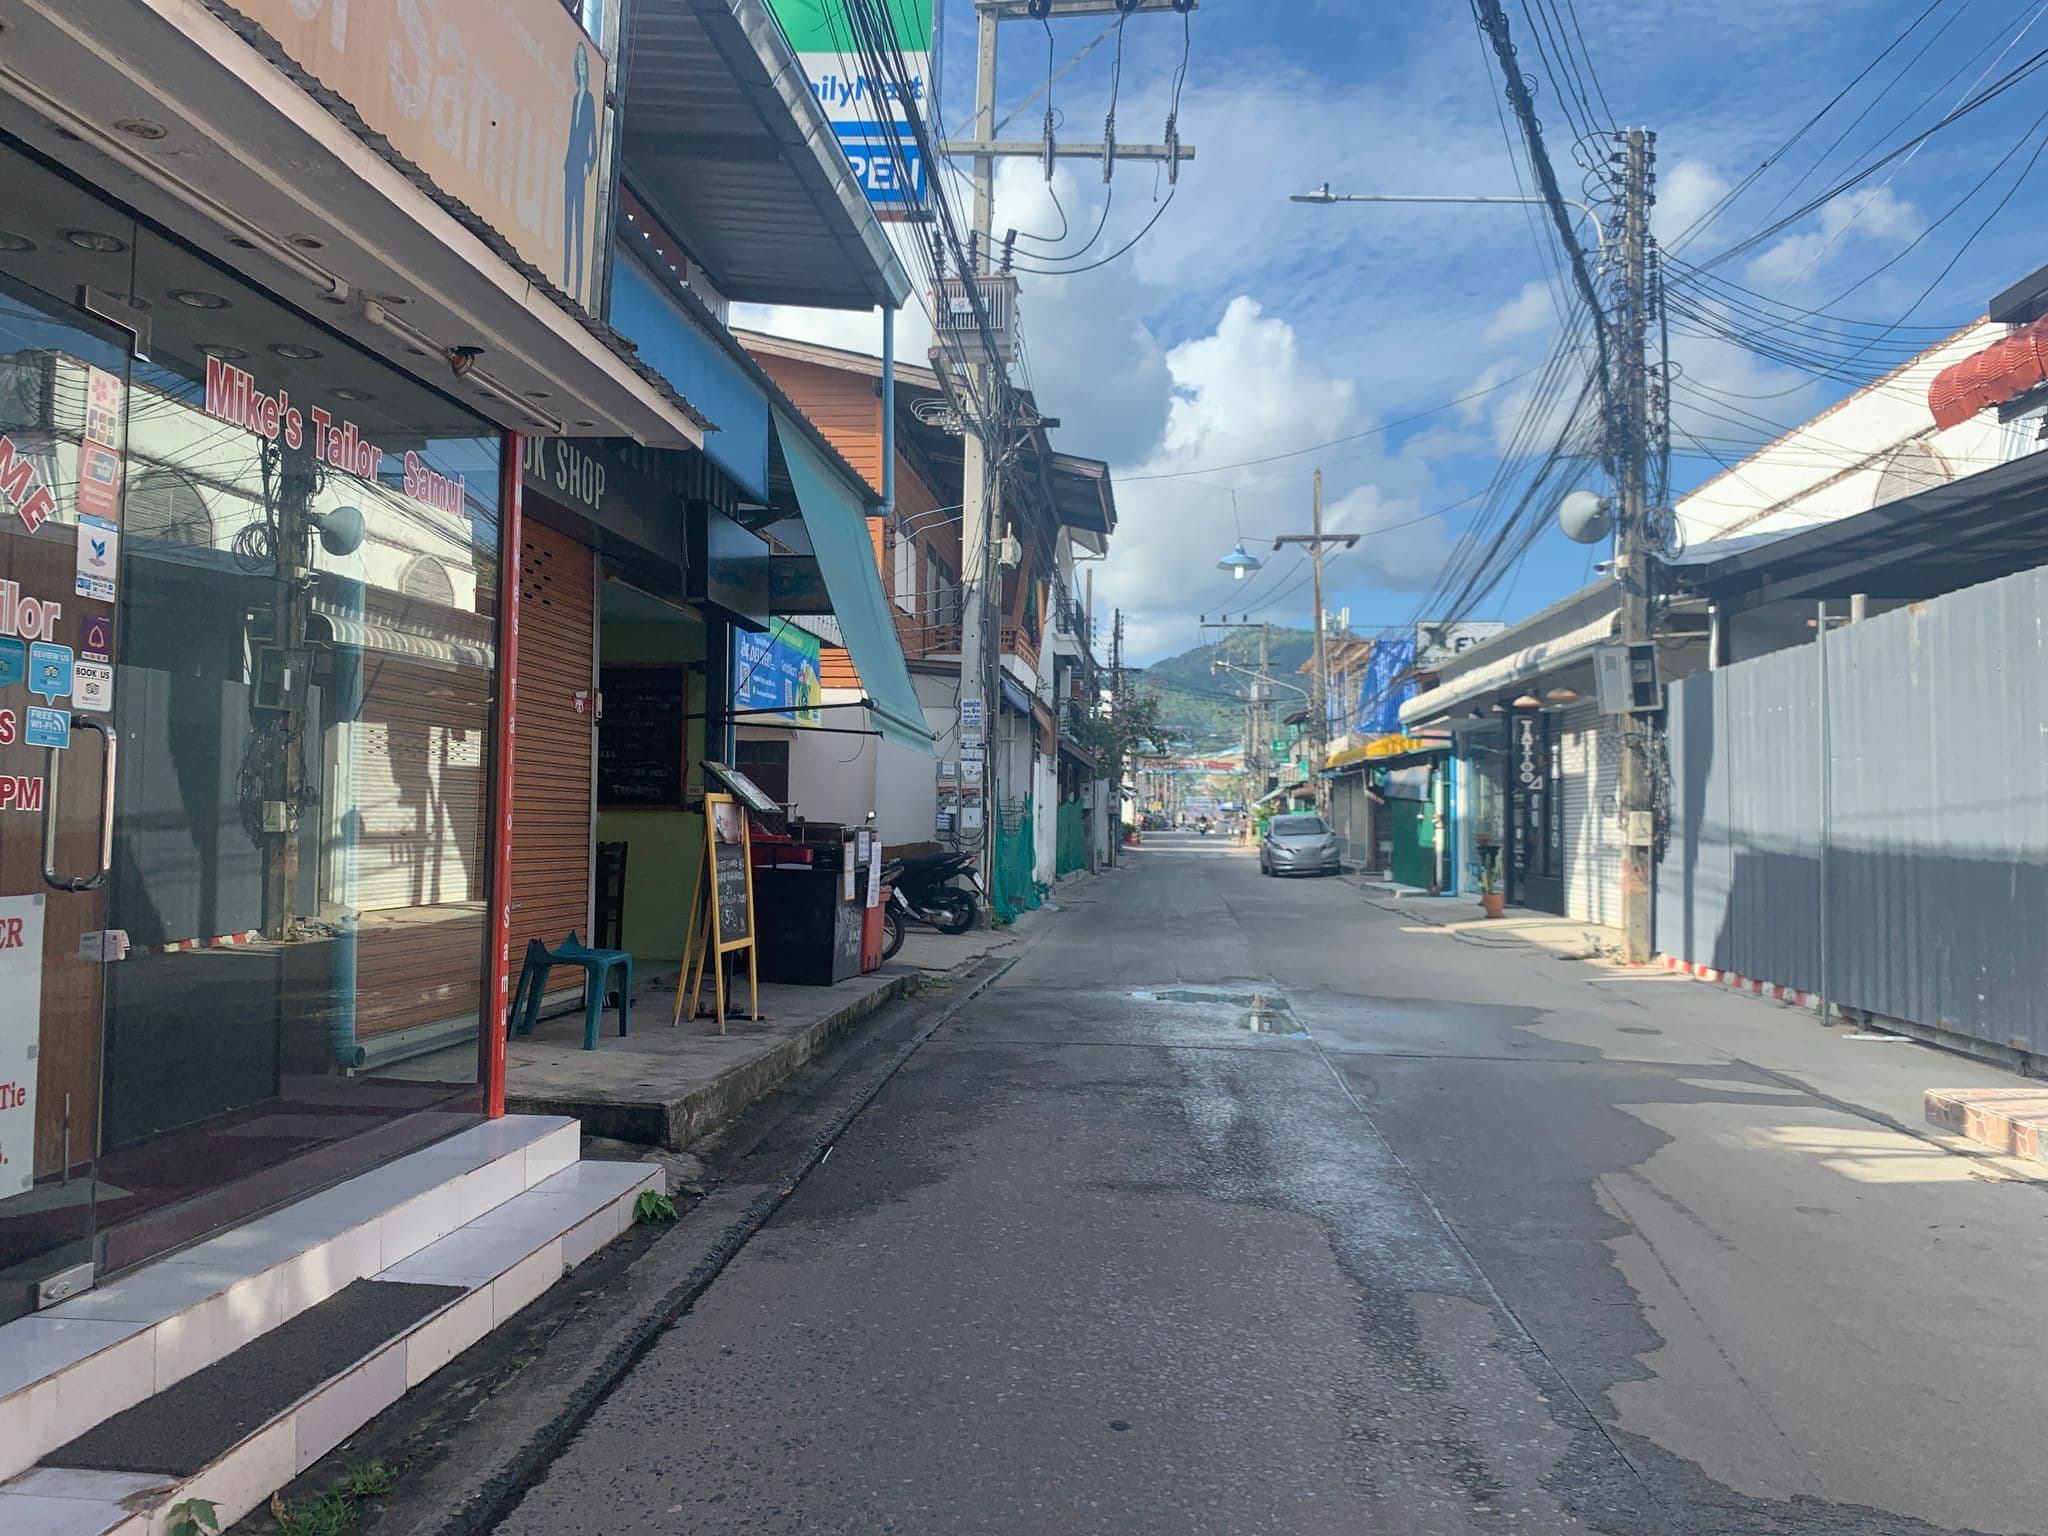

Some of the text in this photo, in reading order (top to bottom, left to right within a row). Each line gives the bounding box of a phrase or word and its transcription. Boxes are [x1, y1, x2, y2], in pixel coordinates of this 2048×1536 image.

[811, 75, 924, 107] ilyMat
[387, 0, 562, 250] Samui
[206, 354, 465, 518] Mike's Tailor Samui
[556, 439, 606, 510] SHOP
[60, 652, 70, 662] US
[75, 667, 110, 679] BOOK US
[30, 709, 54, 720] FREE
[30, 719, 54, 731] WI-FI
[500, 483, 523, 1061] Mike's Tailor Samui
[1519, 720, 1535, 783] TATTOO
